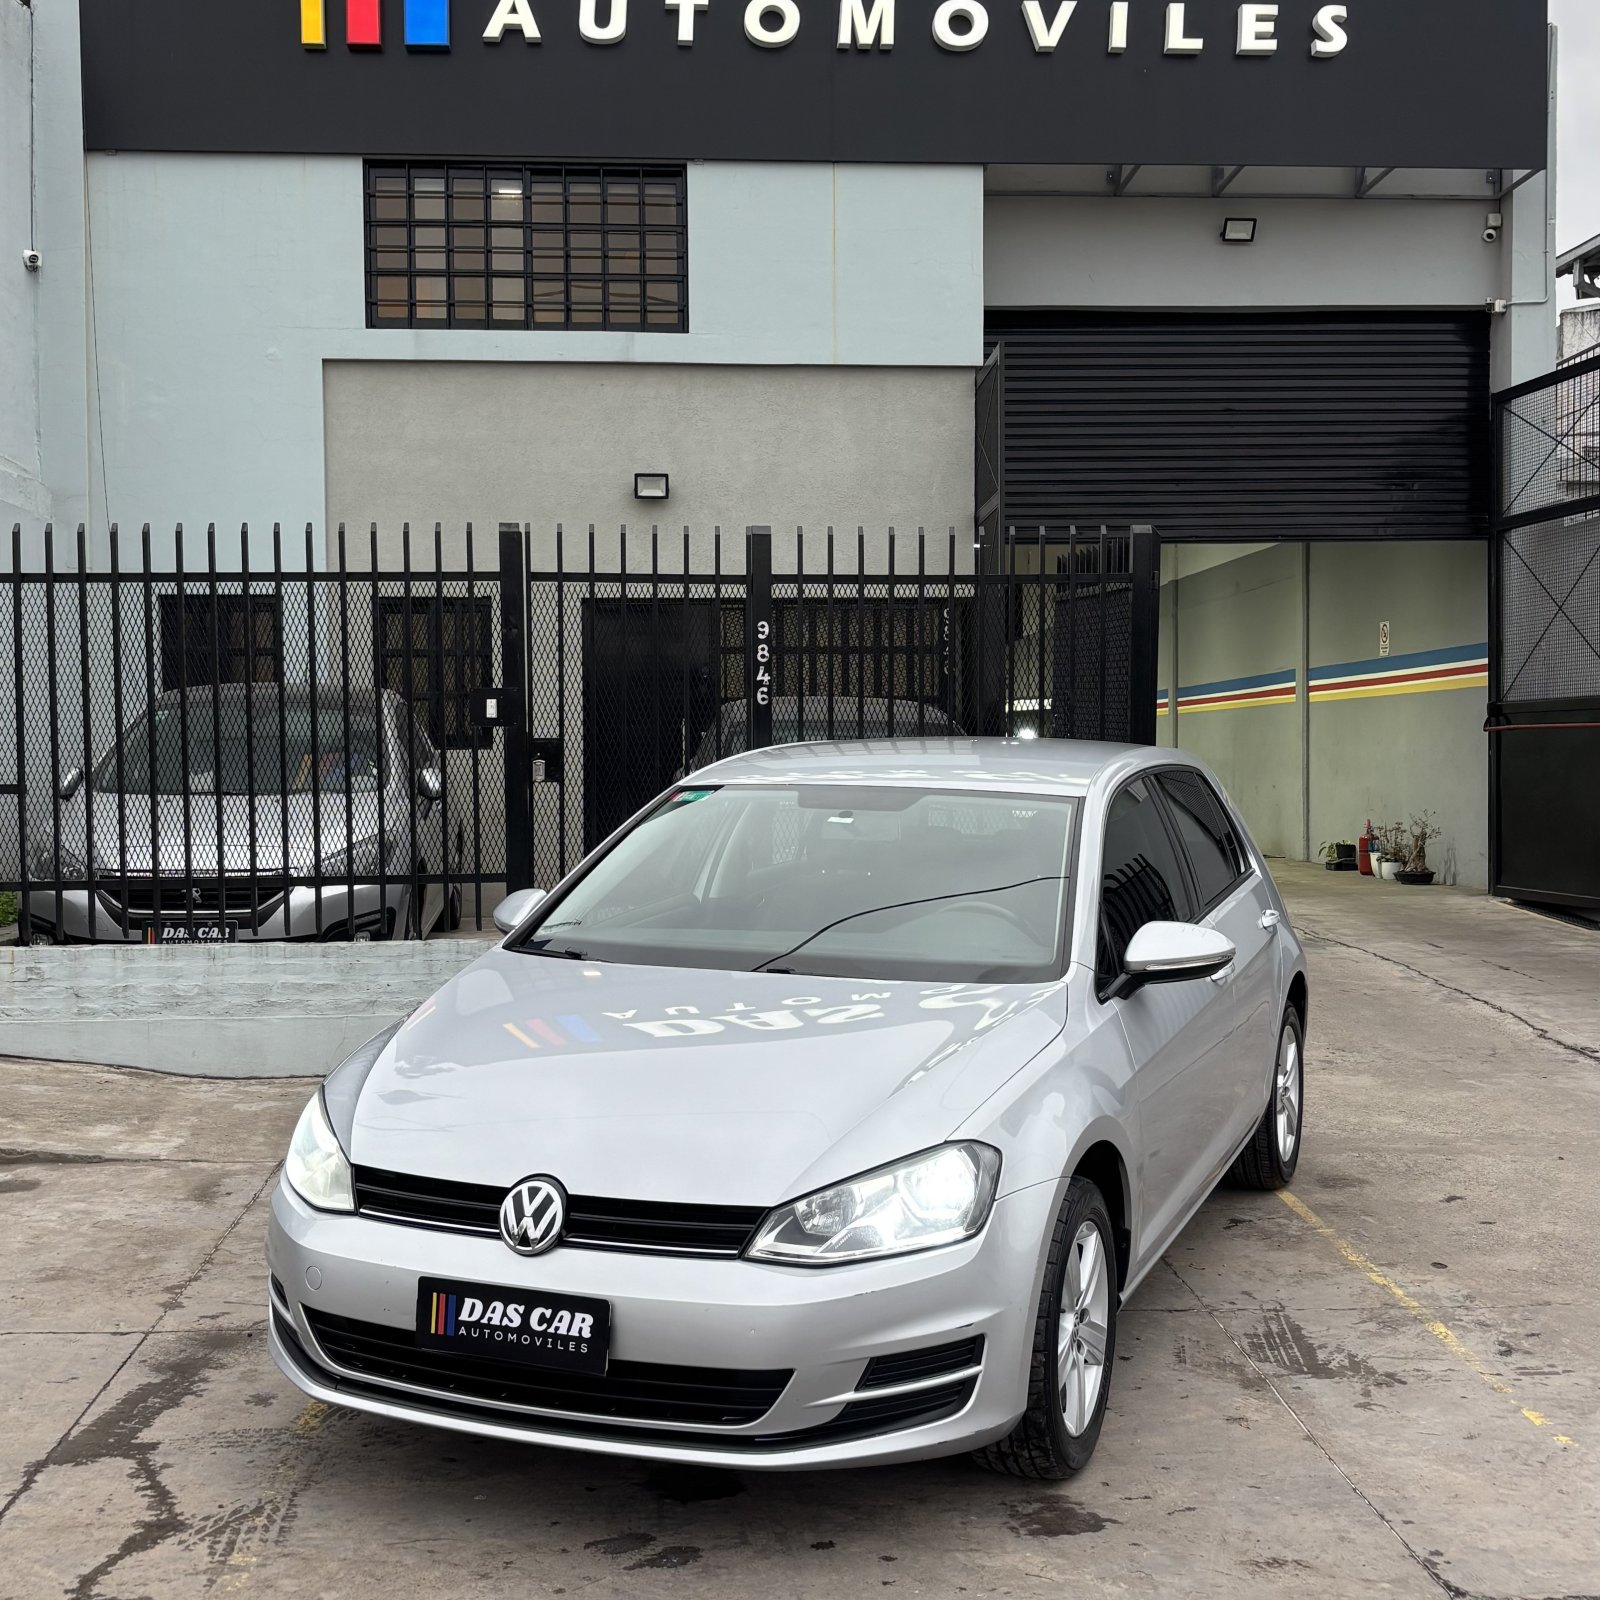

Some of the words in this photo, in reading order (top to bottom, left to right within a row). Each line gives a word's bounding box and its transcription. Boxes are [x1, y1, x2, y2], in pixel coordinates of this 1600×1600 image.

[482, 0, 1348, 58] AUTOMOVILES
[756, 620, 771, 705] 9846
[162, 927, 194, 939] DA
[458, 1297, 525, 1328] DAS
[529, 1307, 594, 1339] CAR
[458, 1326, 589, 1353] AUTOMOVILES
